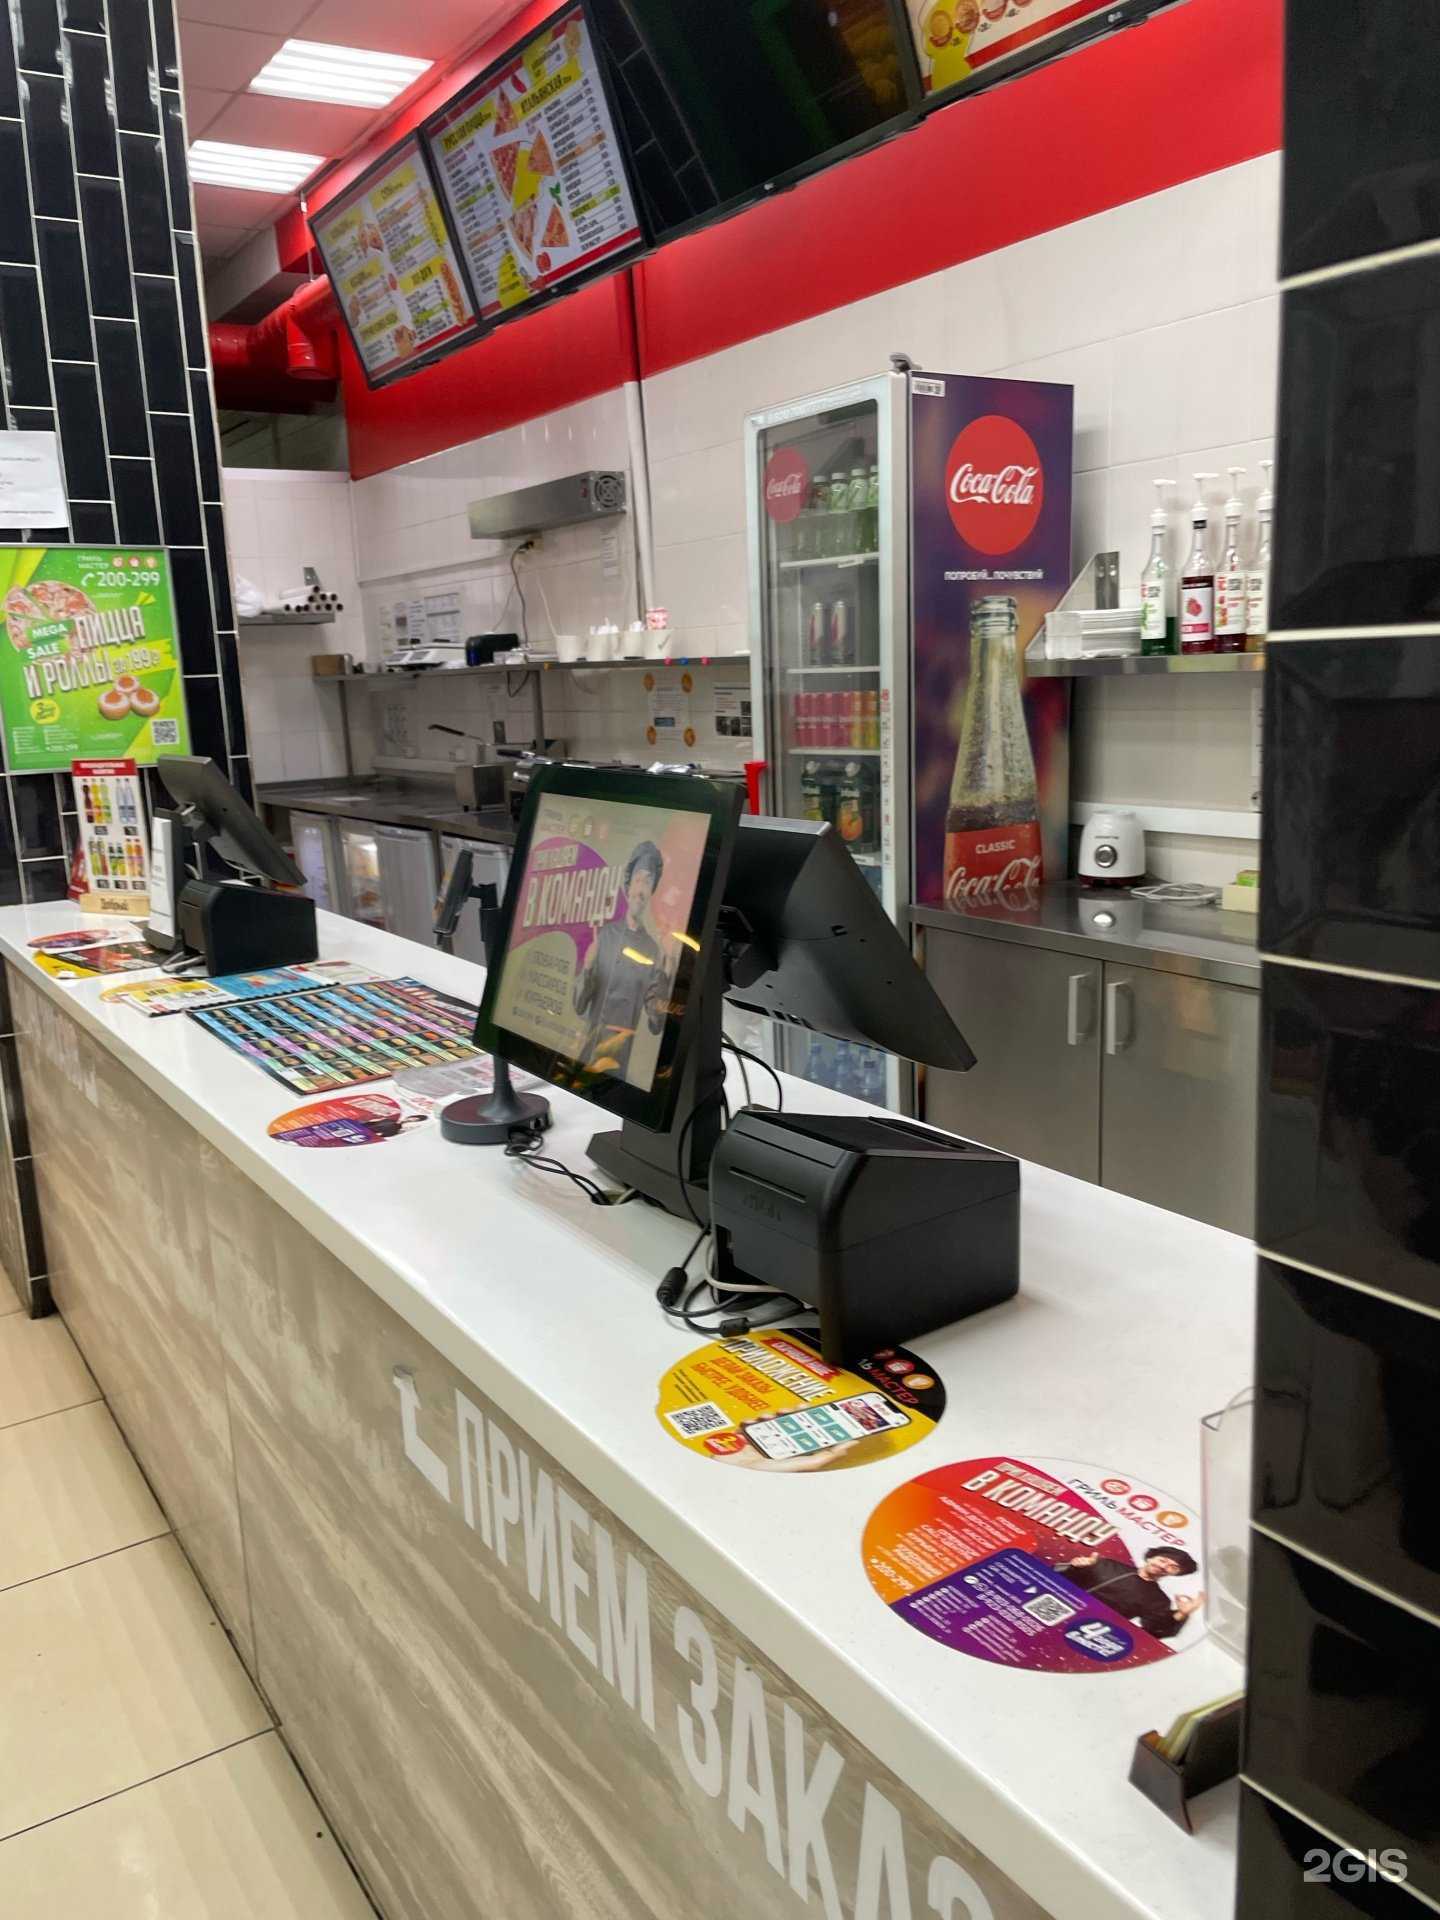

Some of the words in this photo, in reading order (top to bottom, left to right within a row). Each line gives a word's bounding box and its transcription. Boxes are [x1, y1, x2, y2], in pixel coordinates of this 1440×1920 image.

[950, 463, 1040, 505] Coca-Cola
[96, 571, 160, 587] 200-299
[32, 623, 68, 639] MEGA
[74, 606, 146, 649] ПИЦЦА
[26, 642, 60, 660] SALE
[23, 665, 43, 699] И
[42, 648, 113, 695] РОЛЛЫ
[975, 839, 1017, 855] CLASSIC
[522, 877, 539, 928] В
[536, 864, 623, 929] КОМАНДУ
[719, 1337, 837, 1403] ПРИЛОЖЕНИЕ
[961, 1469, 1000, 1492] В
[981, 1479, 1121, 1547] КОМАНДУ
[456, 1388, 655, 1734] ПРИЕМ
[673, 1605, 995, 1920] ЗАКА
